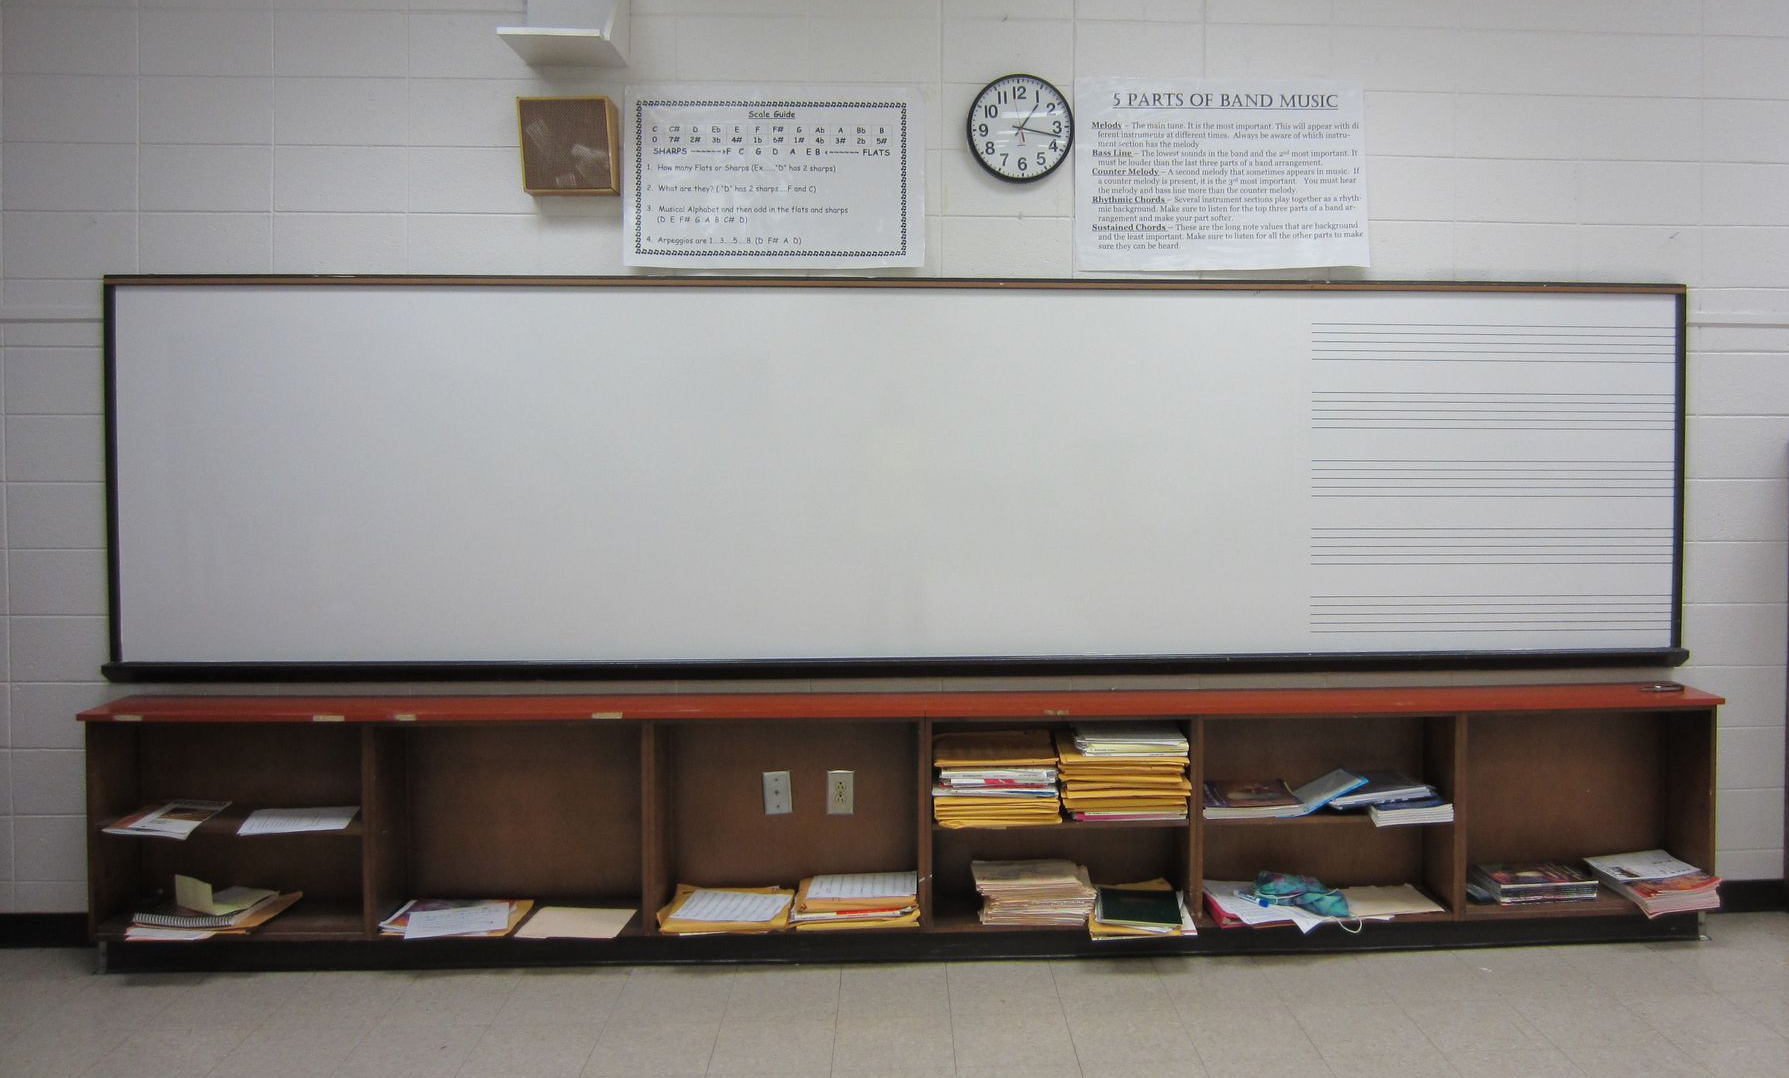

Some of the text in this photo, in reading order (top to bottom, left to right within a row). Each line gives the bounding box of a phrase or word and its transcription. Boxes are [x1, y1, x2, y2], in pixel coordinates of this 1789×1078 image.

[998, 91, 1007, 104] 11
[1013, 87, 1026, 99] 12
[1036, 90, 1039, 103] 1
[1113, 93, 1338, 108] 5 PARTS OF BAND MUSIC
[748, 110, 795, 118] Scale Guide
[985, 105, 998, 118] 10
[1046, 103, 1056, 116] 2
[669, 126, 680, 134] C#
[692, 126, 698, 134] D
[712, 126, 721, 134] Eb
[734, 126, 740, 134] E
[755, 126, 760, 134] F
[772, 126, 784, 134] F#
[796, 126, 802, 134] G
[815, 126, 825, 134] Ab
[838, 126, 843, 134] A
[856, 126, 866, 134] Bb
[879, 126, 884, 134] B
[979, 124, 988, 137] 9
[1053, 121, 1062, 134] 3
[1092, 121, 1122, 131] Melody
[1131, 121, 1145, 130] The
[1147, 122, 1165, 130] main
[1187, 122, 1194, 130] It
[1195, 122, 1201, 130] is
[1202, 122, 1215, 130] the
[1216, 122, 1234, 130] most
[1275, 122, 1290, 130] This
[1292, 122, 1305, 130] will
[1333, 121, 1350, 129] with
[652, 136, 657, 144] 0
[669, 136, 680, 144] 7#
[690, 136, 701, 144] 2#
[712, 136, 721, 144] 3b
[731, 136, 742, 144] 4#
[753, 136, 762, 144] 1b
[773, 136, 784, 144] 6#
[794, 136, 805, 144] 1#
[815, 136, 825, 144] 4b
[835, 136, 846, 144] 3#
[876, 137, 888, 145] 5#
[1098, 130, 1119, 138] ferent
[1121, 131, 1164, 139] instruments
[1175, 131, 1206, 139] different
[1233, 131, 1258, 141] Always
[1259, 131, 1269, 139] be
[1293, 131, 1301, 139] of
[1301, 131, 1323, 139] which
[985, 142, 995, 154] 8
[1049, 139, 1058, 152] 4
[653, 147, 687, 155] SHARPS
[772, 148, 779, 156] D
[789, 148, 796, 156] A
[806, 148, 811, 156] E
[815, 148, 821, 156] B
[862, 148, 890, 156] FLATS
[1092, 149, 1111, 157] Bass
[1113, 149, 1132, 157] Line
[1140, 149, 1154, 157] The
[1156, 149, 1179, 157] lowest
[1181, 149, 1206, 157] sounds
[1208, 149, 1215, 157] in
[1216, 149, 1229, 157] the
[1231, 149, 1249, 157] band
[1251, 149, 1265, 157] and
[1266, 149, 1277, 157] the
[1351, 149, 1358, 157] It
[1000, 153, 1009, 166] 7
[1018, 157, 1027, 170] 6
[1037, 152, 1046, 165] 5
[724, 164, 749, 173] Sharps
[788, 164, 801, 172] has
[802, 164, 808, 172] 2
[809, 164, 836, 174] sharps)
[1092, 167, 1126, 175] Counter
[1128, 167, 1158, 177] Melody
[1167, 168, 1174, 176] A
[1176, 168, 1199, 176] second
[1202, 168, 1227, 177] melody
[1228, 168, 1244, 176] that
[1246, 168, 1285, 176] sometimes
[1316, 167, 1323, 175] in
[1353, 167, 1360, 175] If
[694, 185, 714, 194] they?
[809, 185, 816, 194] C)
[1092, 195, 1131, 205] Rhythmic
[1134, 195, 1165, 204] Chords
[1174, 195, 1200, 203] Several
[1202, 195, 1242, 203] instrument
[1243, 195, 1272, 203] sections
[1274, 195, 1290, 204] play
[1291, 194, 1321, 204] together
[658, 205, 848, 215] Musical Alphabet and then add in the flats and sharps
[1092, 223, 1134, 231] Sustained
[1135, 223, 1166, 231] Chords
[1175, 223, 1198, 231] These
[1213, 222, 1225, 230] the
[1226, 222, 1241, 232] long
[1260, 222, 1284, 230] values
[1285, 222, 1300, 230] that
[1314, 221, 1358, 231] background
[658, 236, 694, 246] Arpeggios
